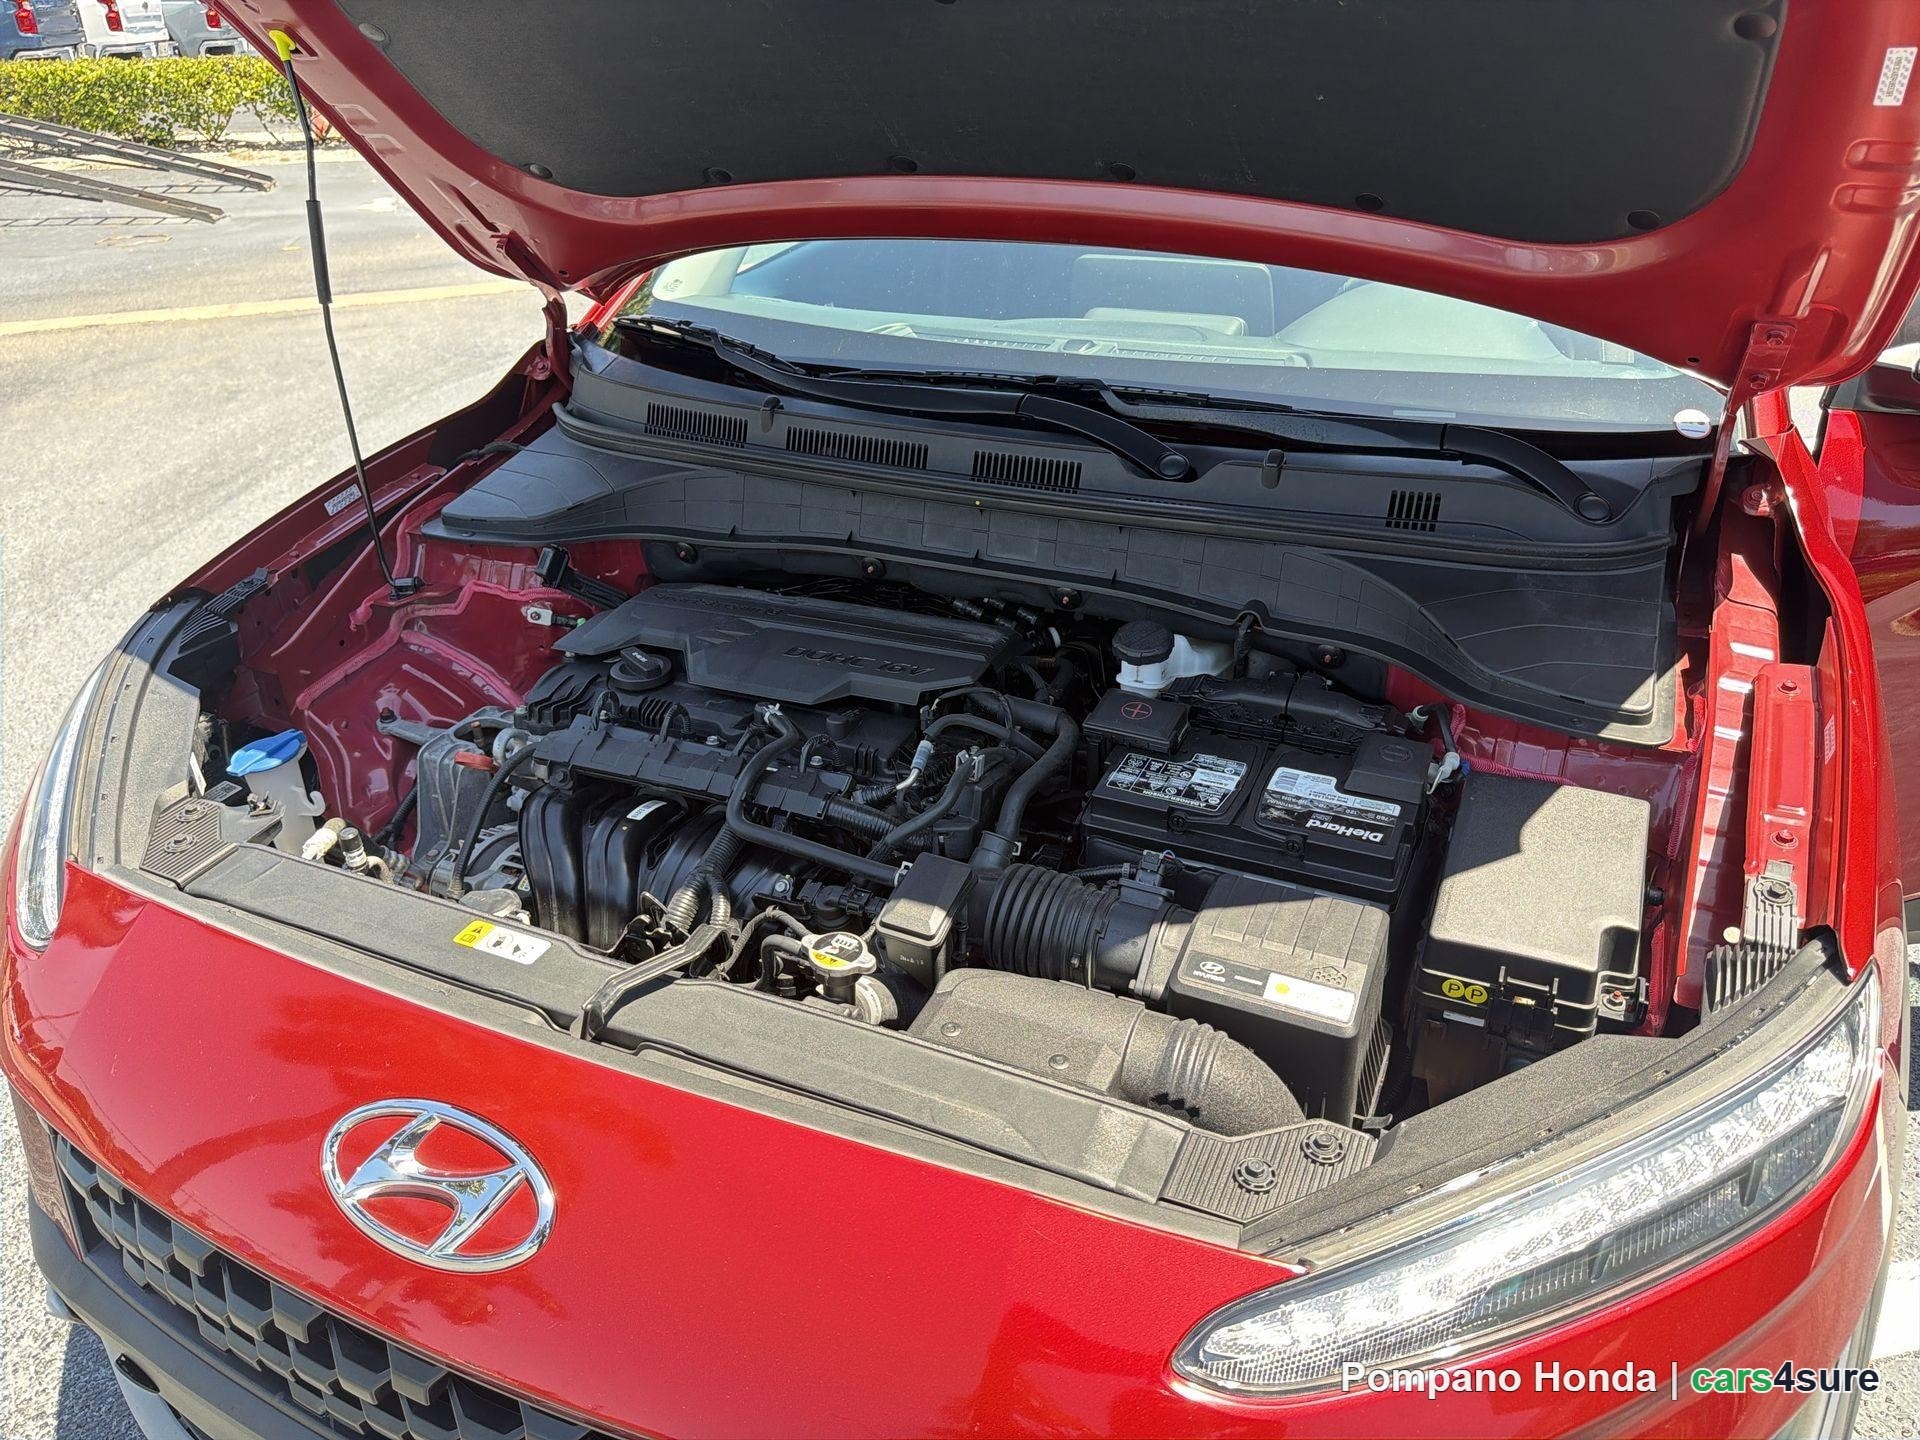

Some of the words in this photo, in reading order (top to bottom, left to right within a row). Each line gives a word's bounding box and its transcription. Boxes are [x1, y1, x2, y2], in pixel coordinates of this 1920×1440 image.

[783, 646, 876, 668] DOHC
[876, 659, 936, 677] 16V
[1305, 818, 1385, 843] DieHard
